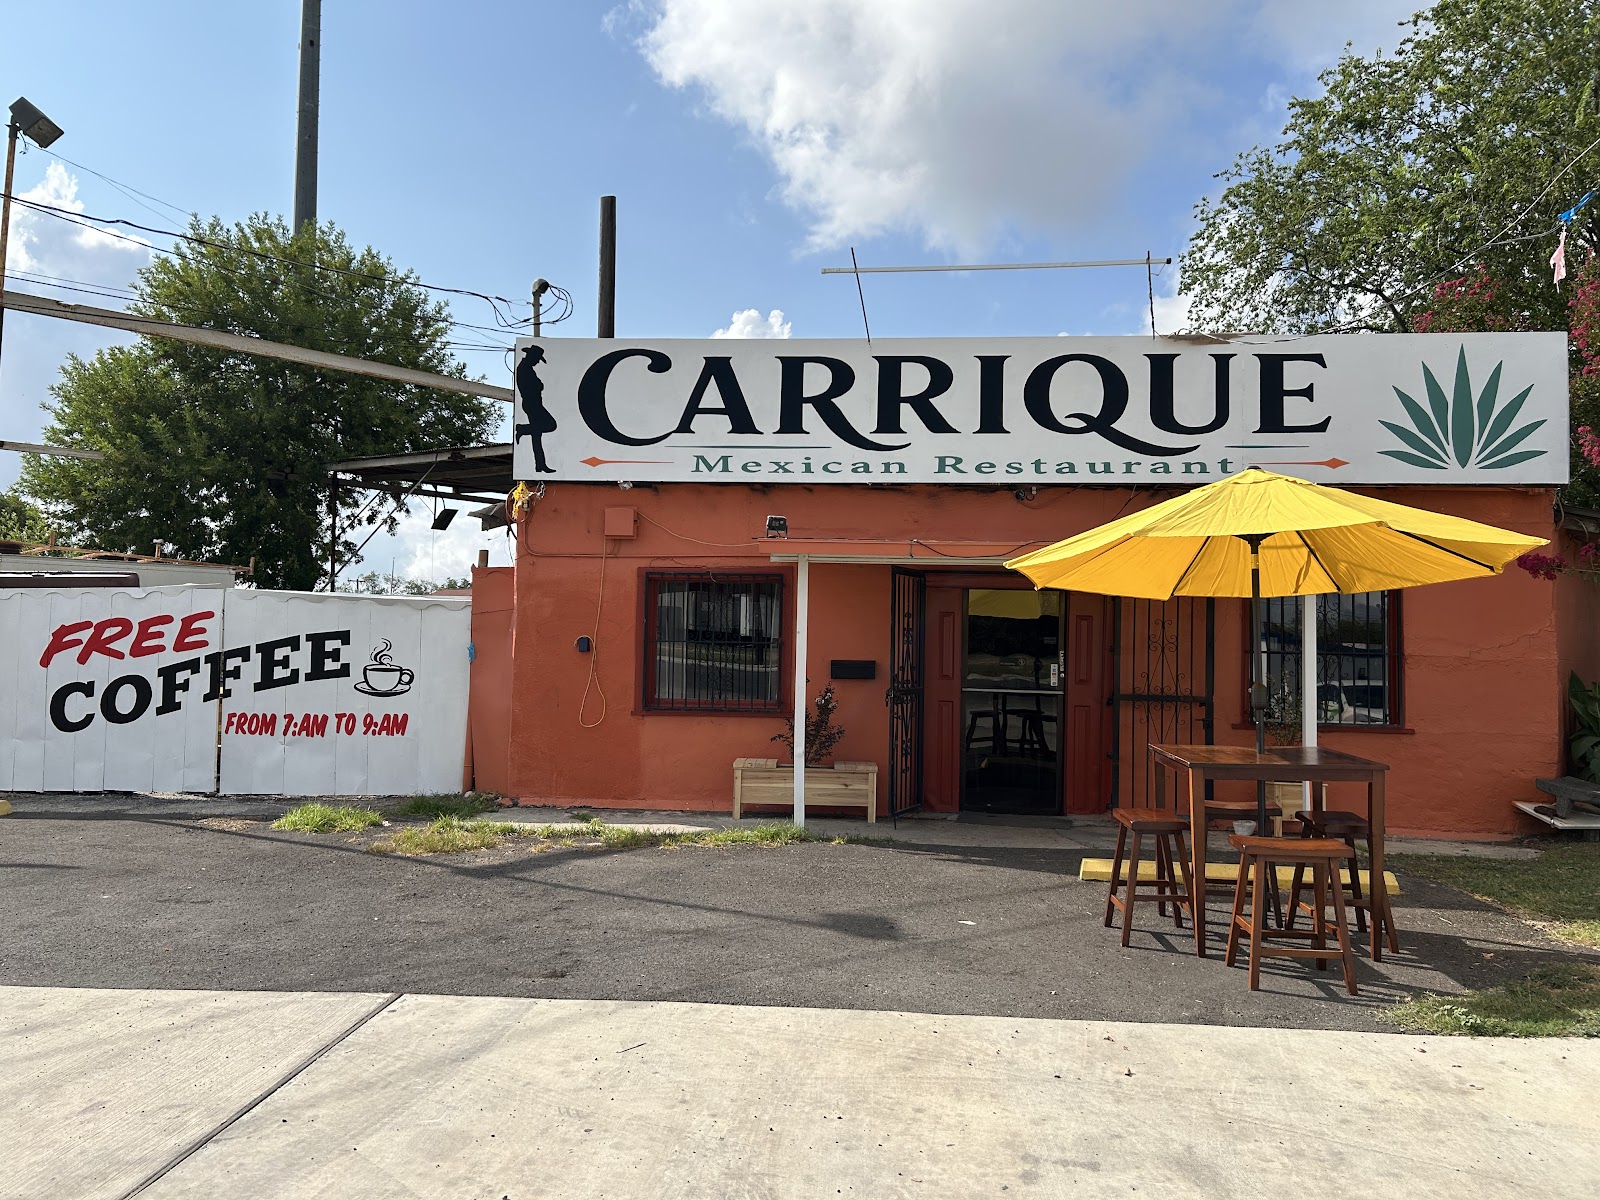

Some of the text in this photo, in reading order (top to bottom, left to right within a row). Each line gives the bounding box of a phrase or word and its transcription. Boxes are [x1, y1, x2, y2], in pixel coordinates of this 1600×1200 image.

[577, 347, 1332, 456] CARRIQUE
[691, 455, 1235, 476] Mexican Restaurant
[40, 610, 215, 668] FREE
[49, 629, 351, 733] COFFEE
[224, 712, 409, 738] FROM 7:AM TO 9:AM
